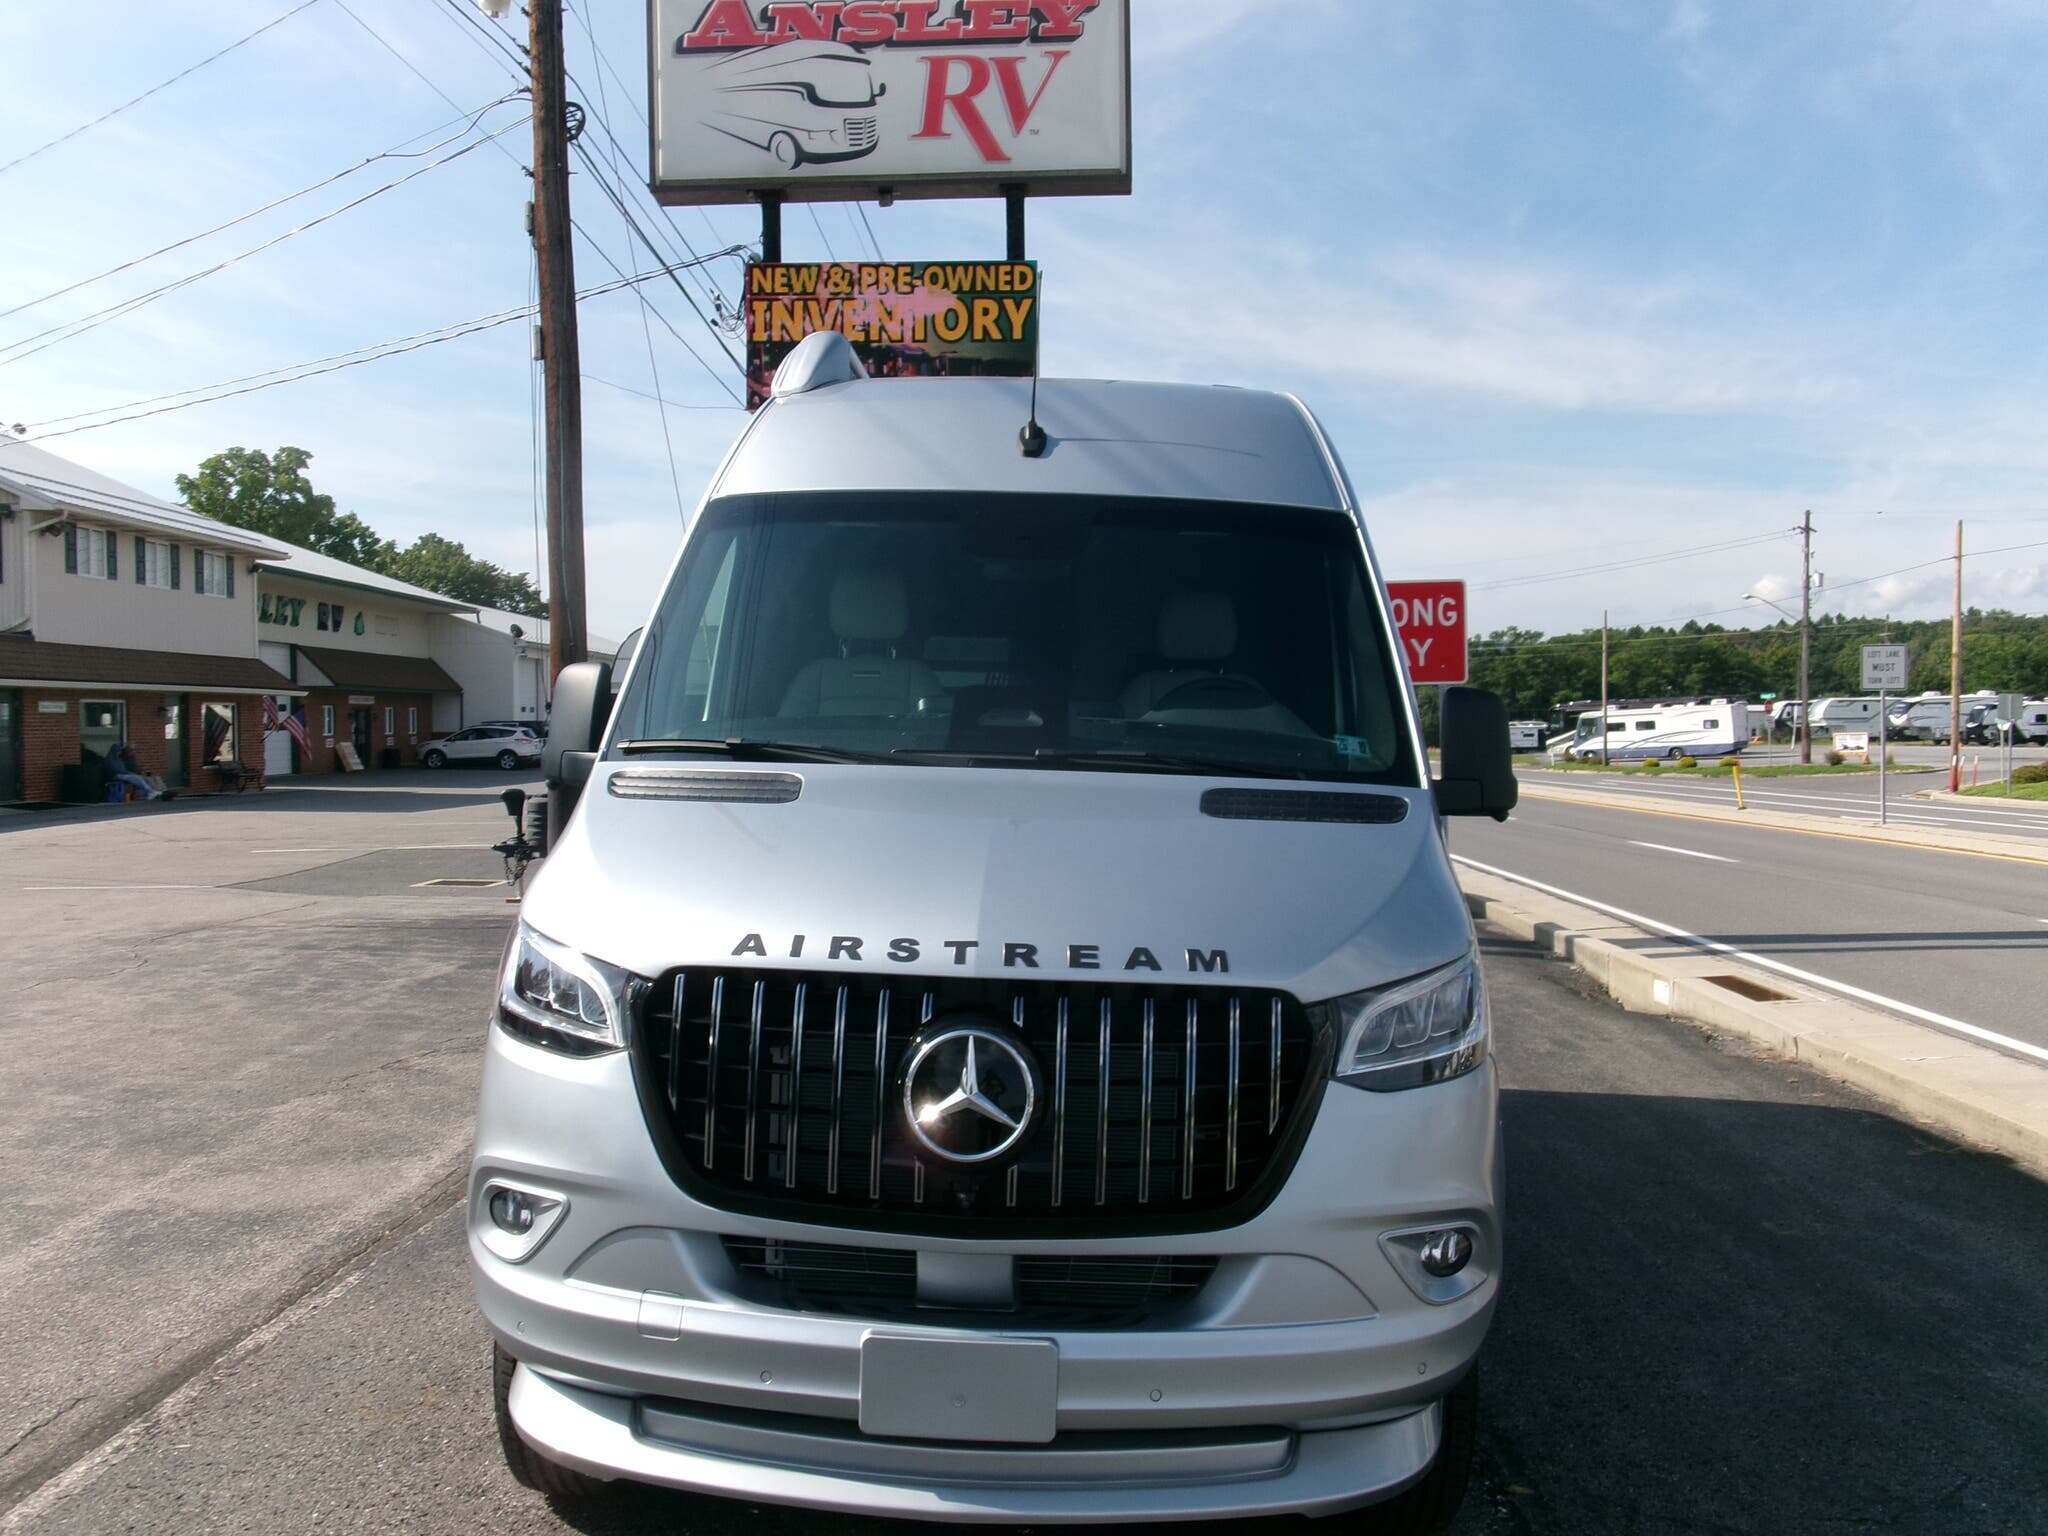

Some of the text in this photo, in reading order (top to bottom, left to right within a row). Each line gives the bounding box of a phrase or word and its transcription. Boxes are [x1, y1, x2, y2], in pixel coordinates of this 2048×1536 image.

[678, 0, 1097, 53] ANSLEY
[910, 50, 1070, 162] RV
[751, 264, 1035, 295] NEW & PRE-OWNED
[257, 593, 344, 632] LEY RV
[1391, 597, 1457, 627] ONG
[731, 933, 1229, 973] AIRSTREAM
